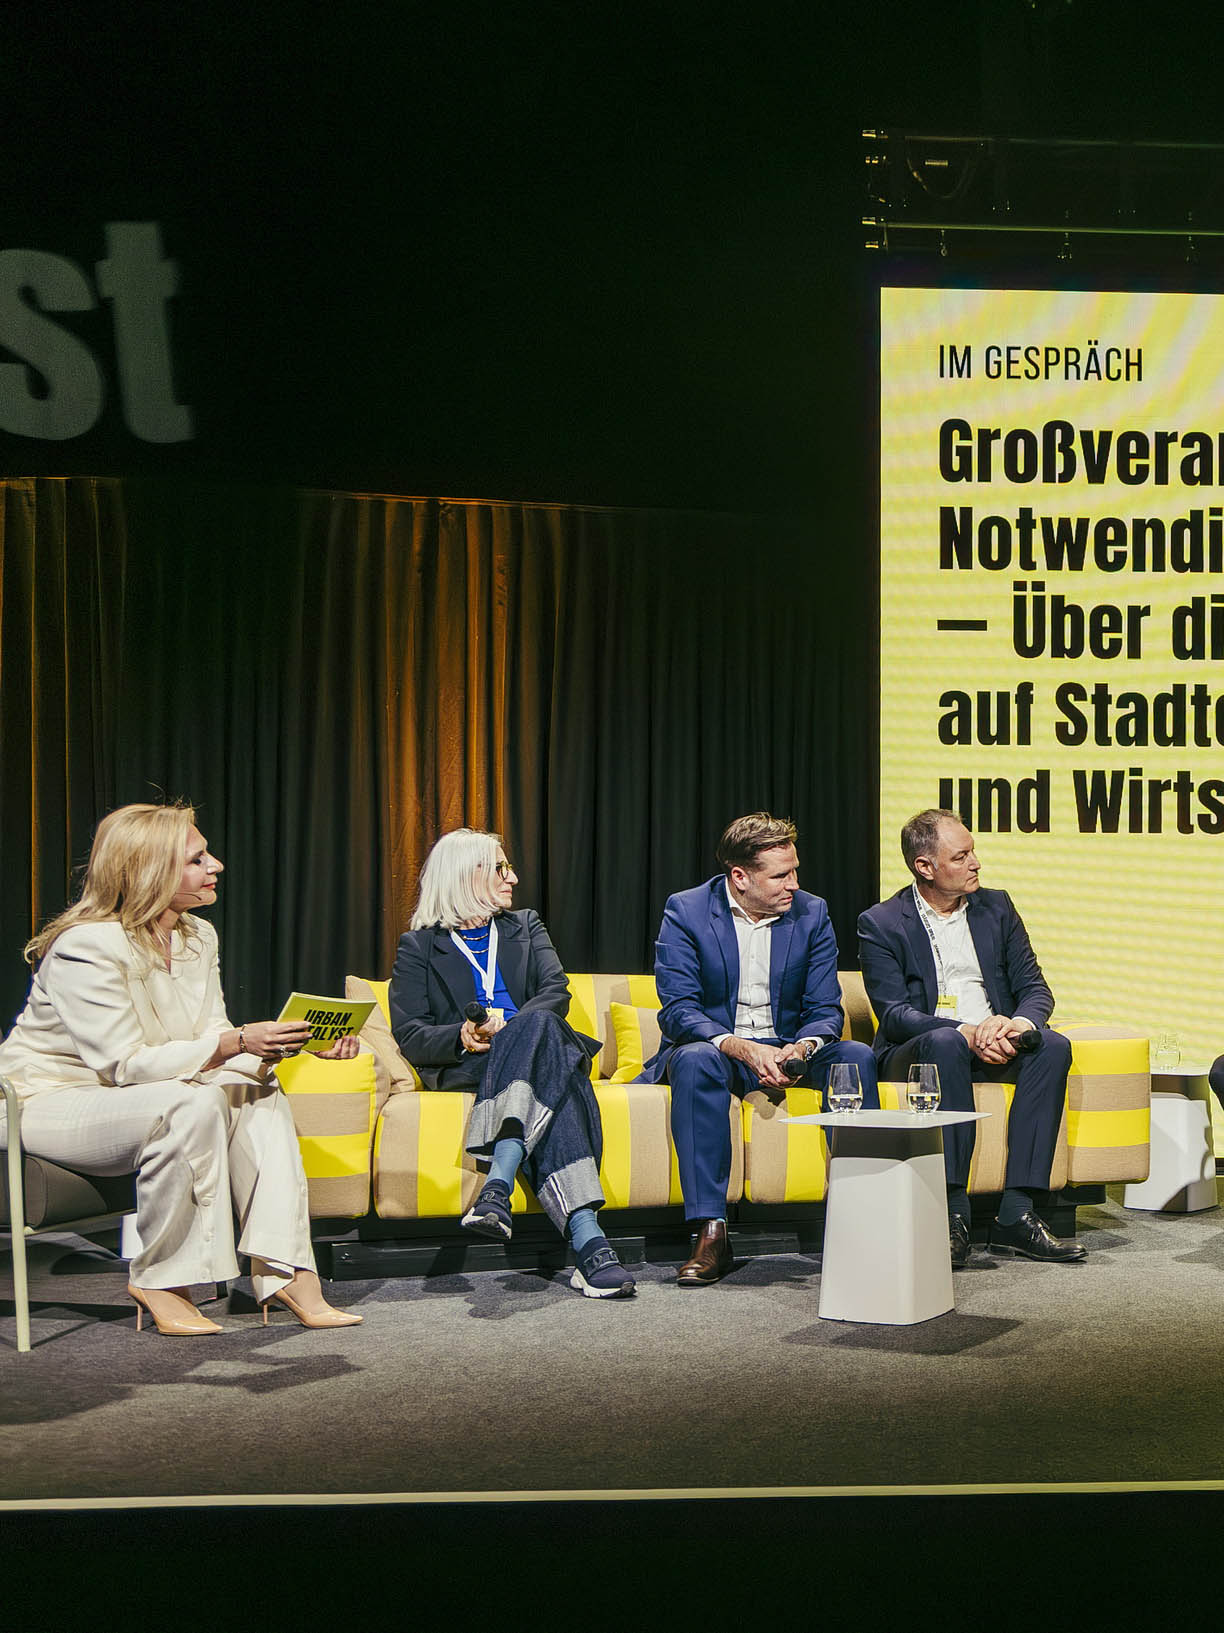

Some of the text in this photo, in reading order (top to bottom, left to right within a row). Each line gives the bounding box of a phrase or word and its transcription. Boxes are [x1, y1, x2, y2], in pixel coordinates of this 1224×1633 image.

[940, 340, 1142, 381] IM GESPRÄCH
[1013, 581, 1150, 659] Über
[938, 682, 1033, 745] auf
[938, 768, 1051, 834] und
[304, 1009, 352, 1025] URBAN
